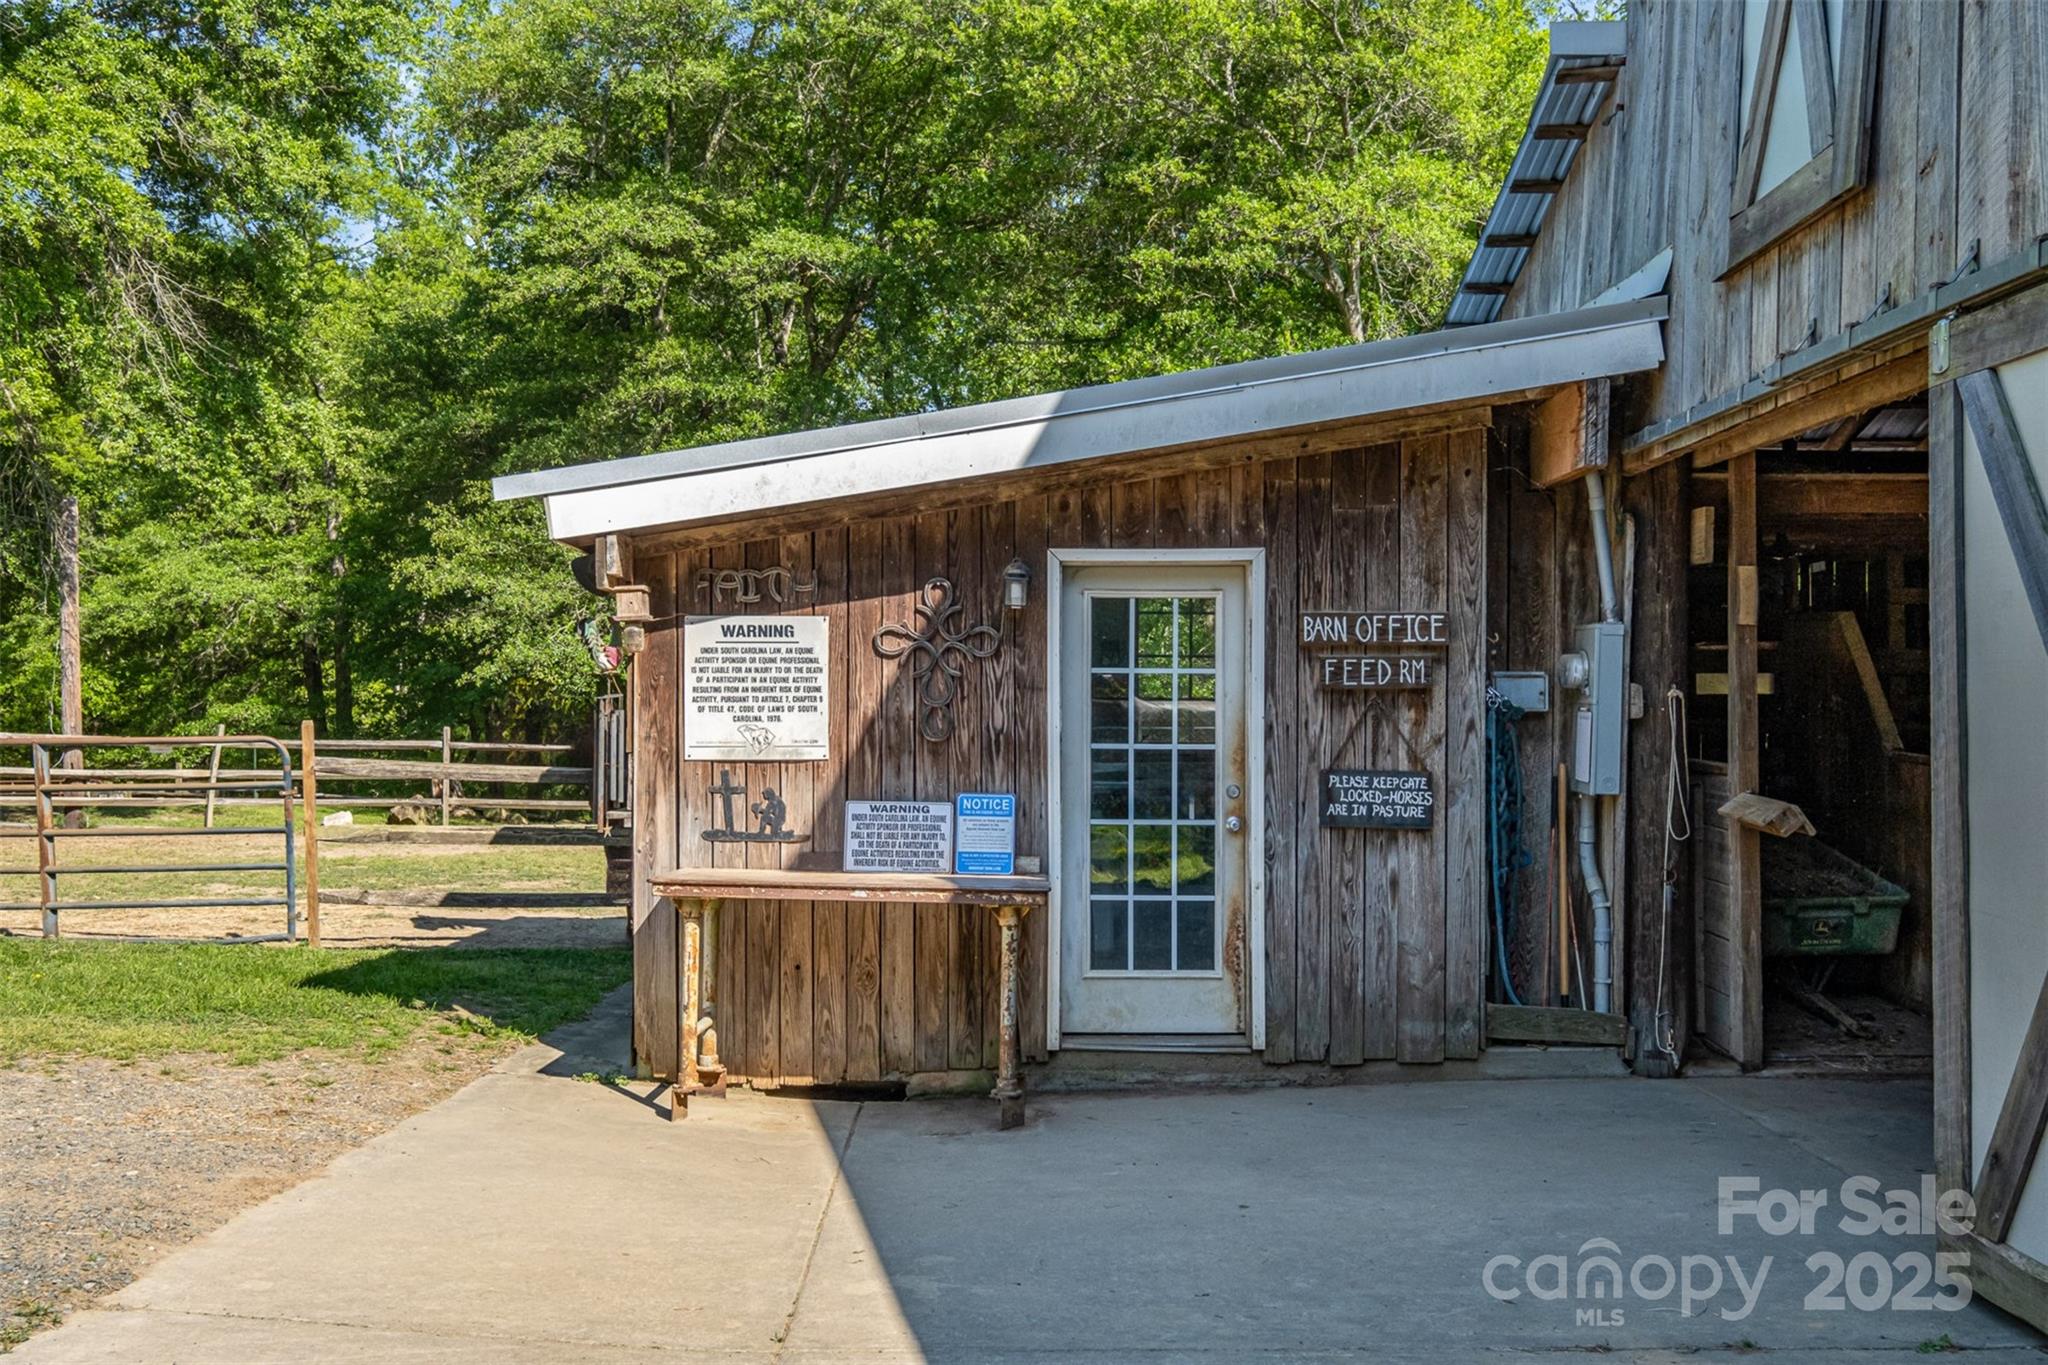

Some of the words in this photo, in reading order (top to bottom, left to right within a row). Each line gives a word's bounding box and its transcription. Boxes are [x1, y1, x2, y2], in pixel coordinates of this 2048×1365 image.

[694, 566, 818, 604] FAITH
[721, 625, 795, 638] WARNING
[1303, 616, 1347, 642] BARN
[1355, 615, 1446, 643] OFFICE
[700, 647, 718, 655] UNDER
[720, 647, 739, 655] SOUTH
[740, 647, 767, 655] CAROLINA
[769, 647, 784, 655] LAW,
[785, 647, 793, 655] AN
[794, 647, 814, 655] EQUINE
[691, 666, 697, 674] IS
[698, 666, 709, 674] NOT
[711, 666, 730, 674] LIABLE
[732, 666, 743, 674] FOR
[744, 666, 752, 674] AN
[754, 666, 773, 674] INJURY
[774, 666, 782, 674] TO
[783, 666, 792, 674] OR
[794, 666, 804, 674] THE
[805, 666, 823, 674] DEATH
[1325, 659, 1391, 686] FEED
[1399, 659, 1426, 683] RM
[697, 705, 705, 713] OF
[708, 705, 724, 713] TITLE
[739, 705, 755, 713] CODE
[757, 705, 765, 713] OF
[767, 705, 785, 713] LAWS
[787, 705, 795, 713] OF
[797, 705, 818, 713] SOUTH
[1328, 775, 1369, 788] PLEASE
[1372, 776, 1398, 789] KEEP
[1398, 777, 1428, 790] GATE
[869, 804, 930, 814] WARNING
[963, 798, 1010, 810] NOTICE
[1327, 804, 1348, 816] ARE
[1351, 804, 1367, 816] IN
[1371, 805, 1426, 818] PASTURE
